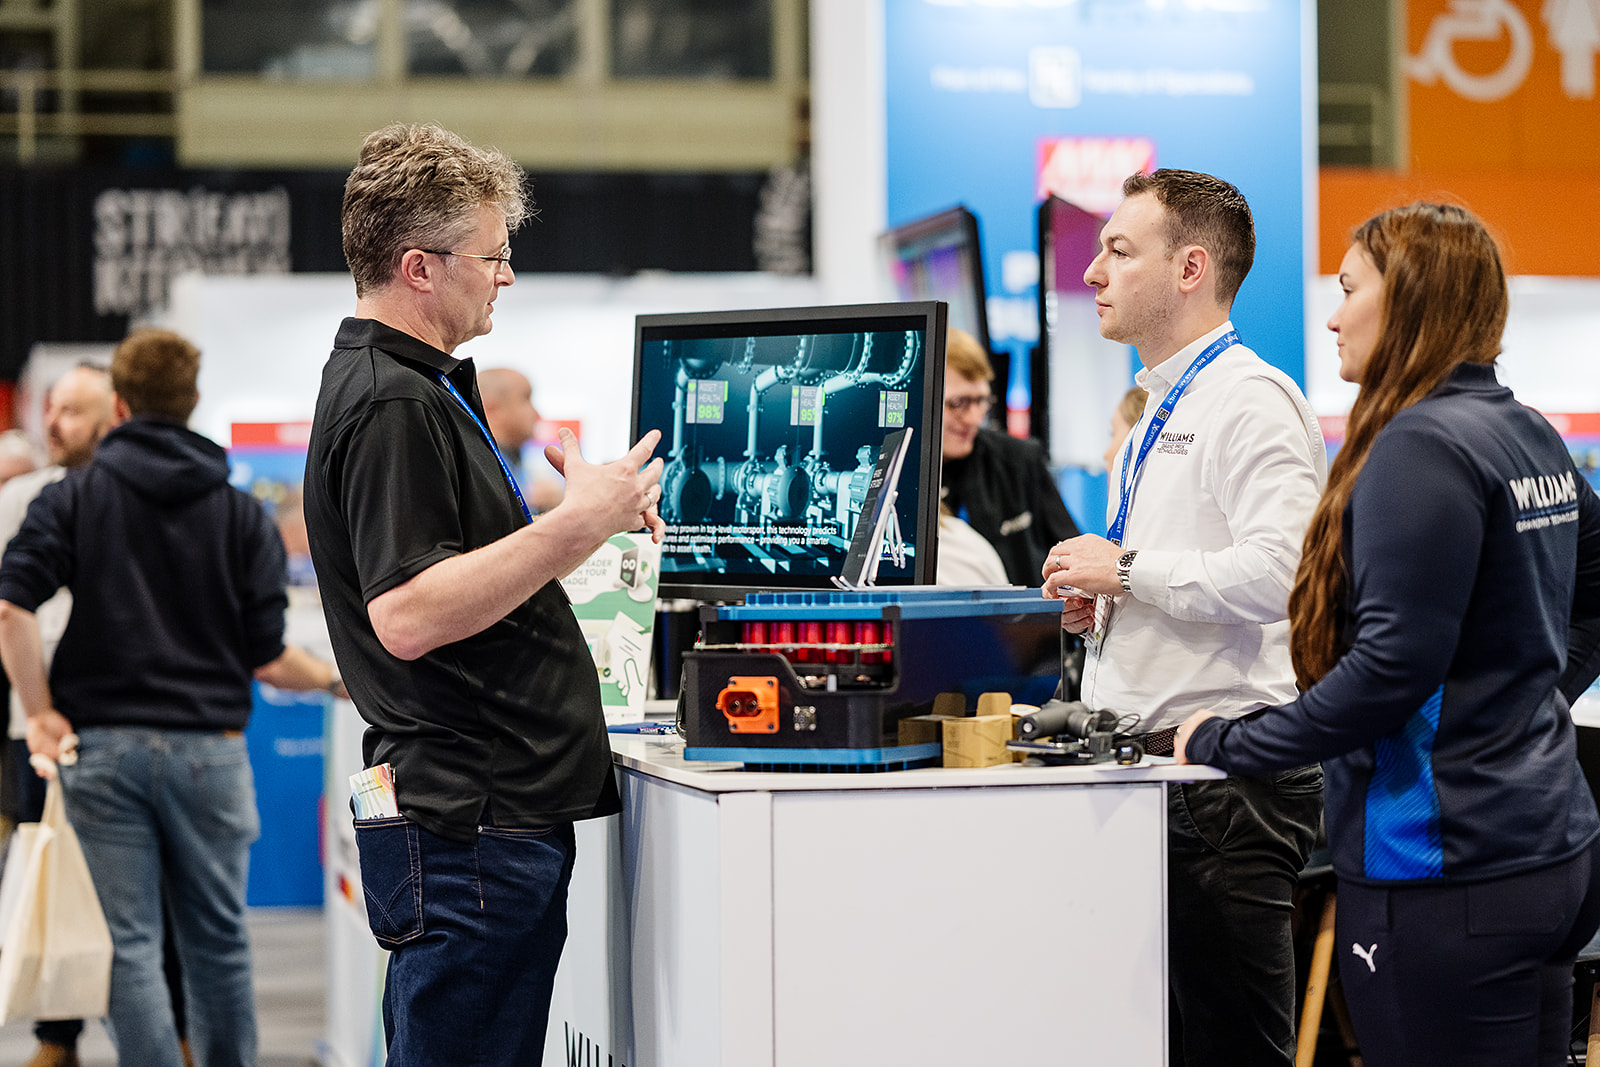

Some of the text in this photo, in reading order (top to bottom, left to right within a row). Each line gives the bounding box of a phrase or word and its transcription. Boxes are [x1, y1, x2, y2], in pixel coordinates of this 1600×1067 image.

[698, 404, 721, 419] 98%
[887, 412, 903, 423] 97%
[1160, 432, 1195, 442] WILLIAMS
[680, 526, 700, 535] proven
[707, 525, 732, 535] top-level
[733, 526, 765, 536] motorsport,
[767, 526, 777, 534] this
[779, 526, 811, 536] technology
[812, 526, 837, 536] predicts
[678, 535, 689, 543] and
[718, 535, 754, 545] performance
[760, 535, 787, 546] providing
[789, 537, 800, 546] you
[806, 537, 829, 545] smarter
[586, 568, 607, 576] YOUR
